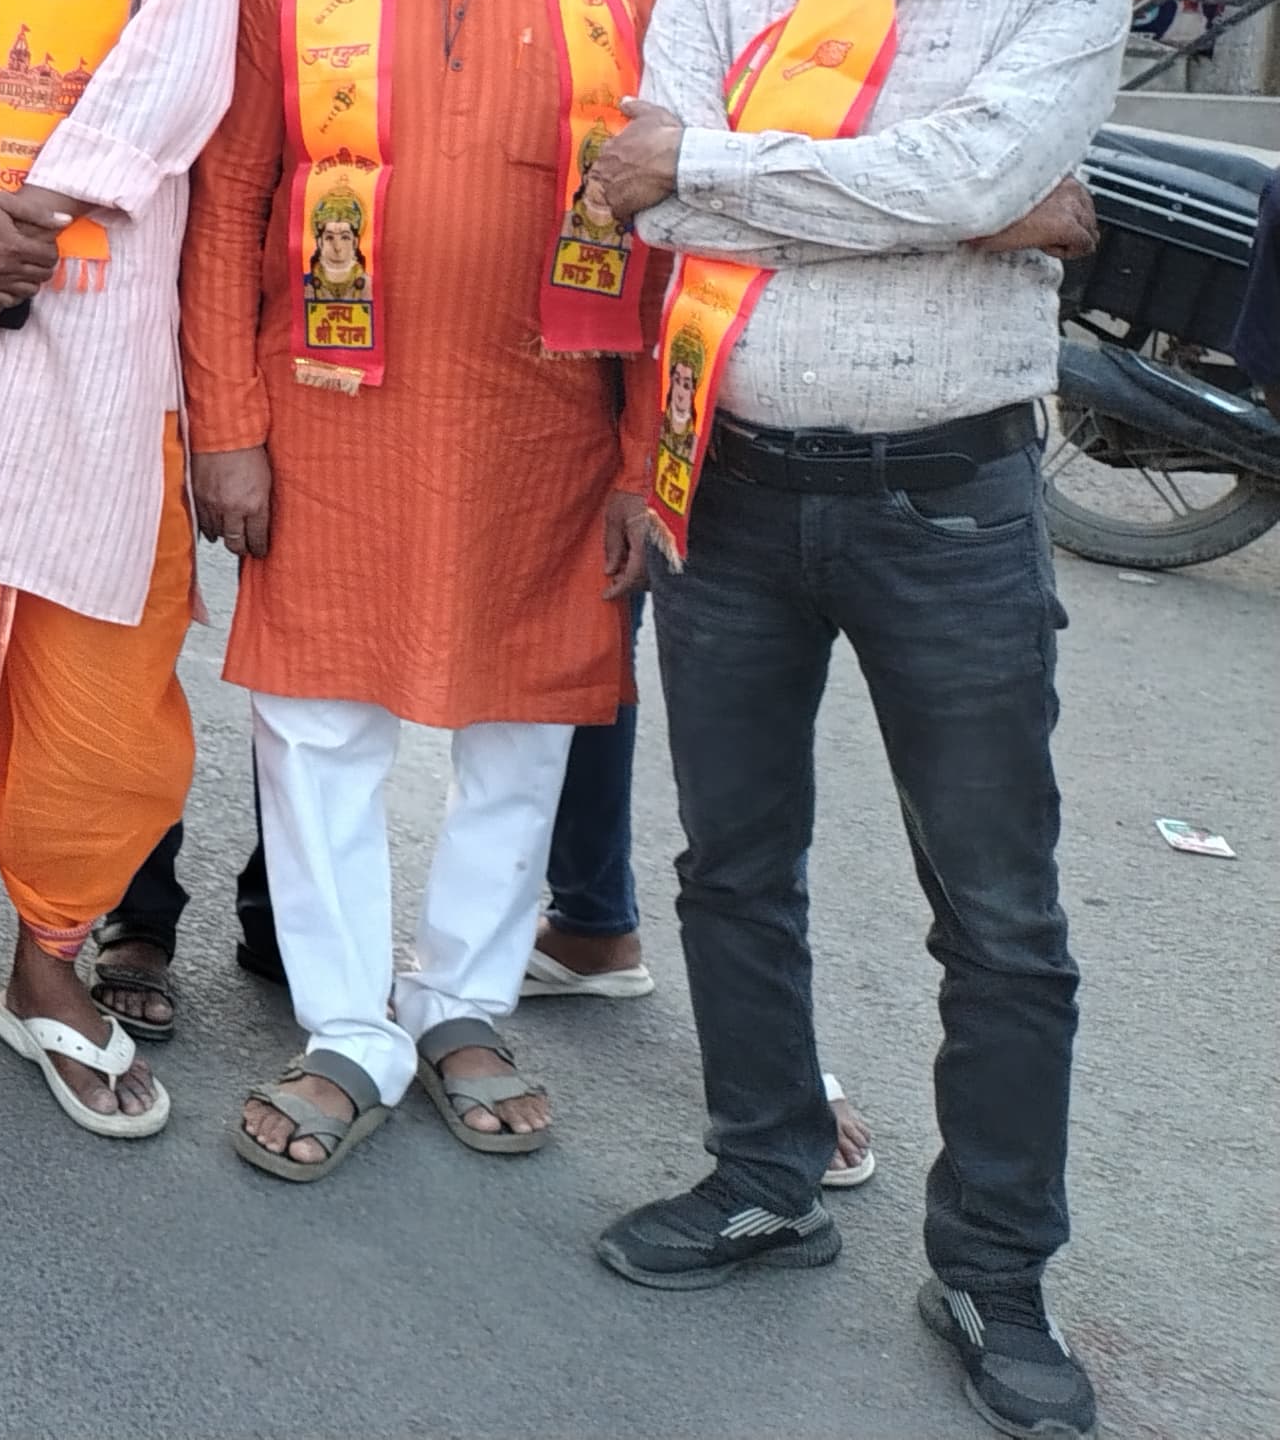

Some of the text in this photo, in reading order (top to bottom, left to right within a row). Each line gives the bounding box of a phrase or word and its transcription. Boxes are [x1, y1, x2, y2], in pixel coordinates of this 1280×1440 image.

[326, 304, 354, 325] जय
[315, 317, 366, 345] श्री राम
